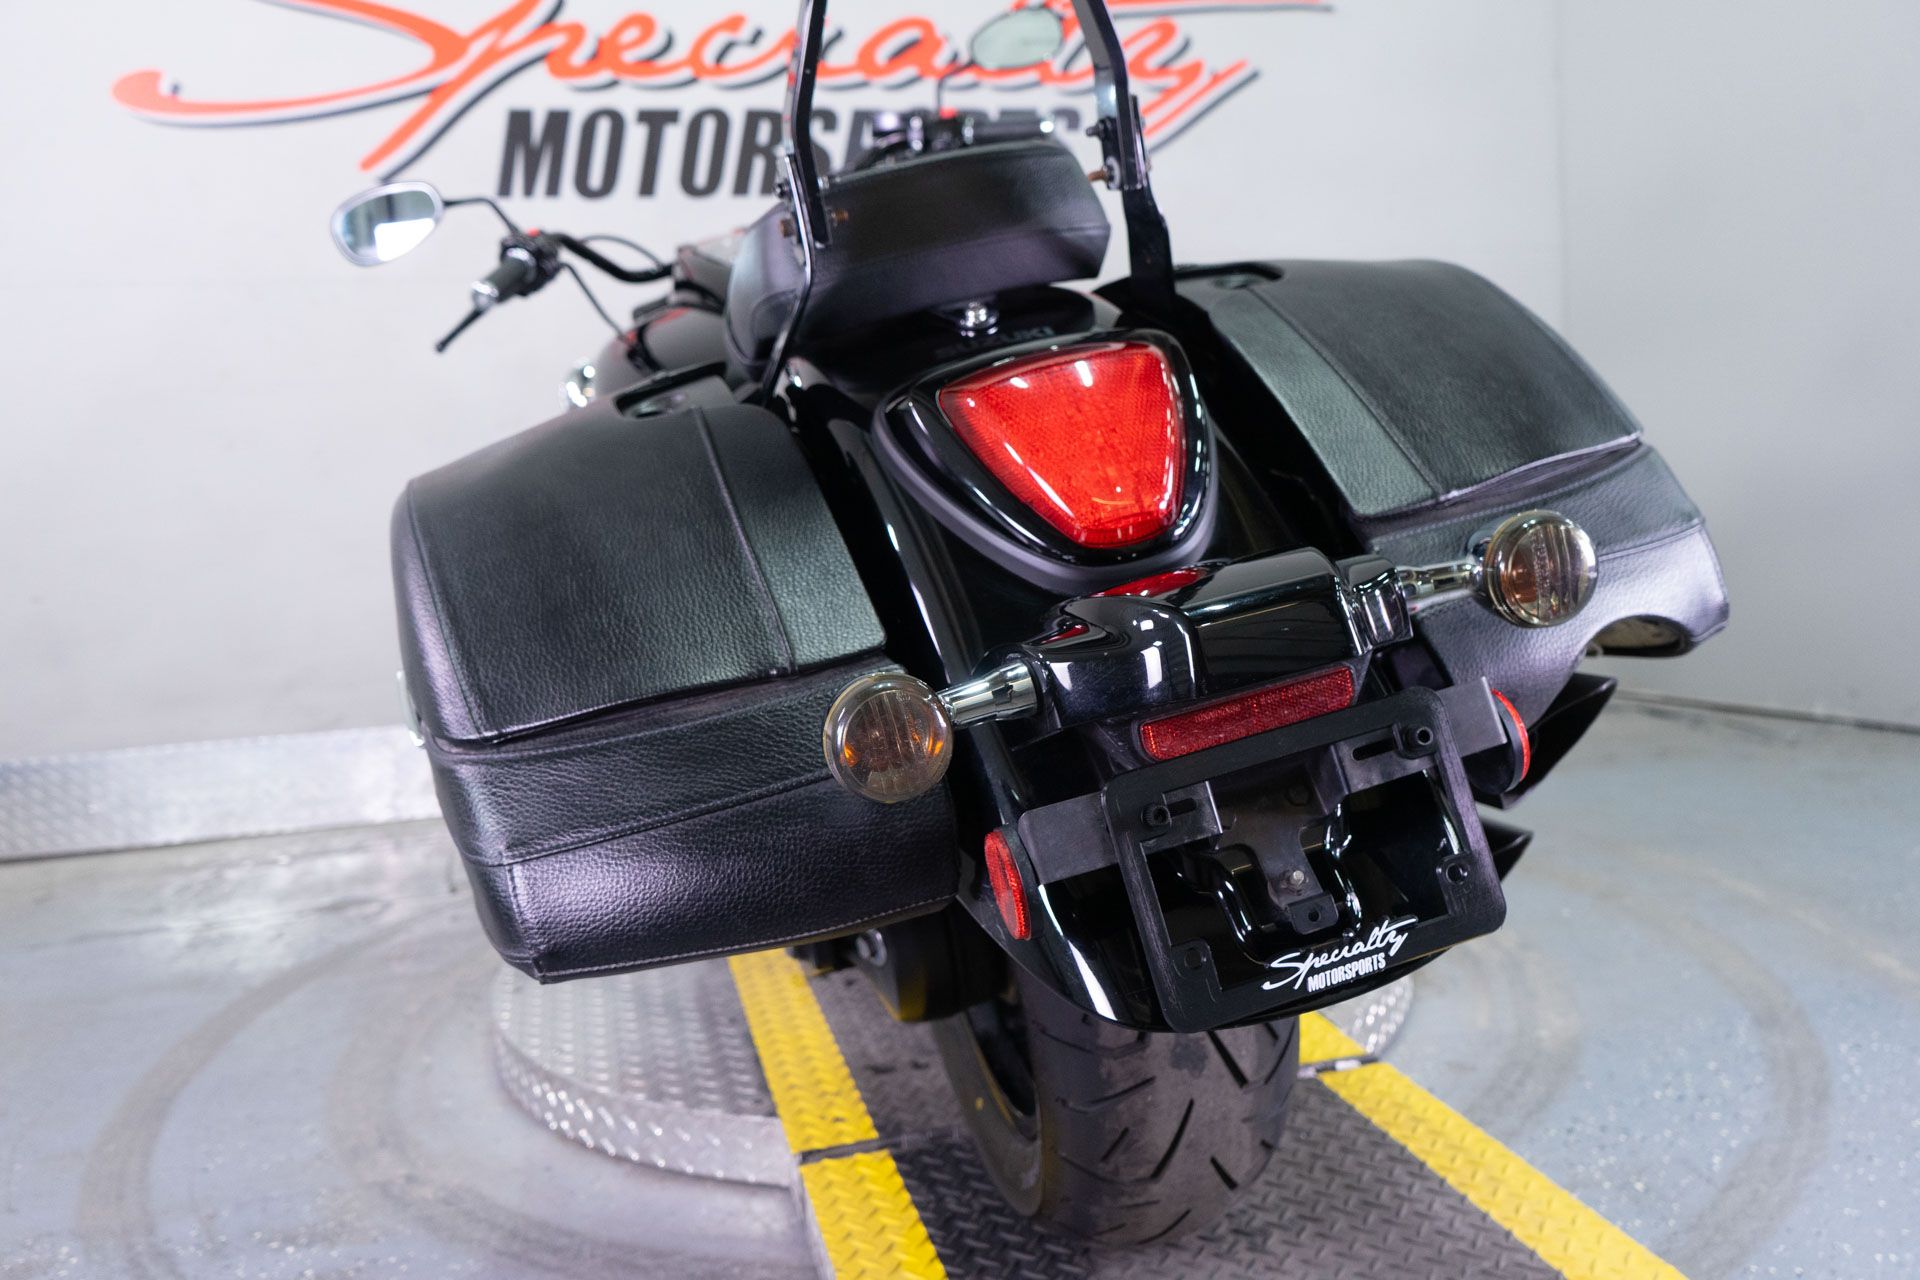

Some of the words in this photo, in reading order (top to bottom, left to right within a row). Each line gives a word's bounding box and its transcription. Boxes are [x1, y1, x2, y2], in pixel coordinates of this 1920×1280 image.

[111, 0, 1322, 171] Speciaty
[499, 109, 1080, 199] MOTORSP
[1261, 918, 1418, 990] Specialty
[1307, 952, 1387, 992] MOTORSPORTS
